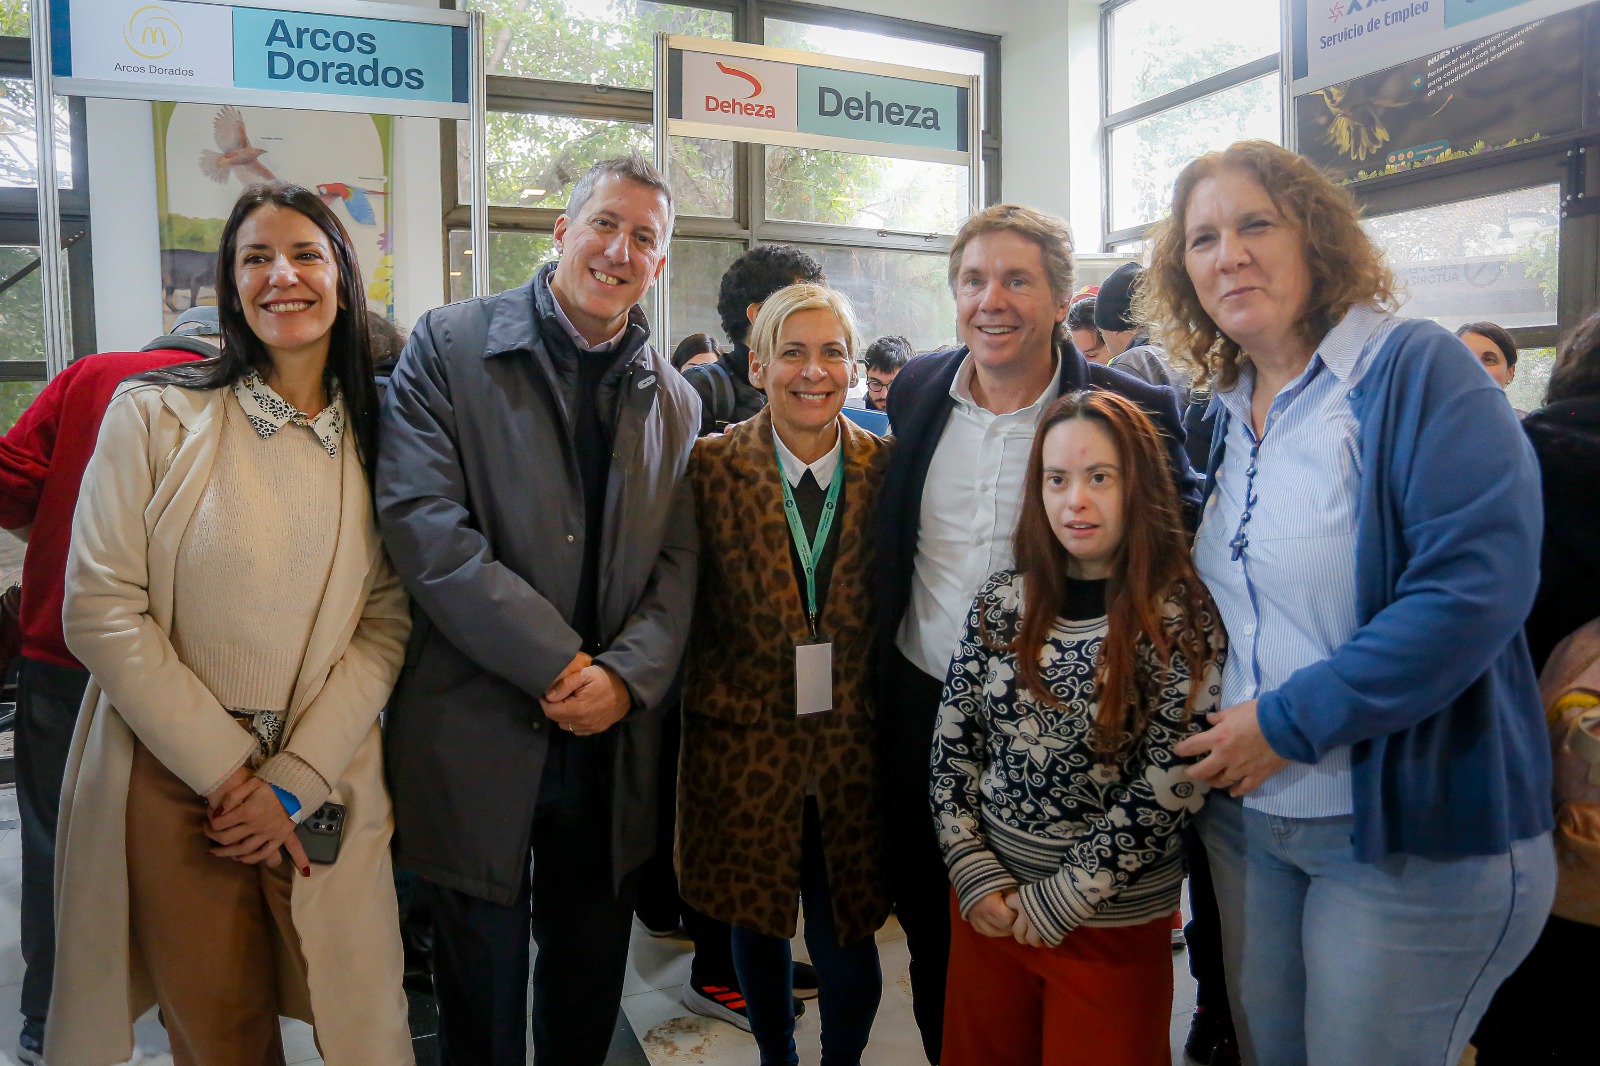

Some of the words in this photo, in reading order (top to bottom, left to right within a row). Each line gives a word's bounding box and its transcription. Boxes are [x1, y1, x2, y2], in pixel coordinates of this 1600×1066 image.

[264, 18, 377, 55] Arcos
[1319, 24, 1364, 50] Servicio
[1366, 17, 1381, 33] de
[1384, 1, 1429, 26] Empleo
[114, 62, 146, 74] Arcos
[149, 65, 195, 77] Dorados
[267, 50, 425, 90] Dorados
[1427, 76, 1442, 89] para
[1442, 57, 1475, 79] contribuir
[1475, 50, 1489, 61] con
[1489, 45, 1496, 53] la
[1427, 89, 1436, 97] de
[1437, 84, 1443, 92] la
[1444, 58, 1489, 88] biodiversidad
[1489, 40, 1525, 62] argentina.
[1459, 50, 1471, 61] sus
[705, 95, 776, 119] Deheza
[818, 85, 941, 131] Deheza
